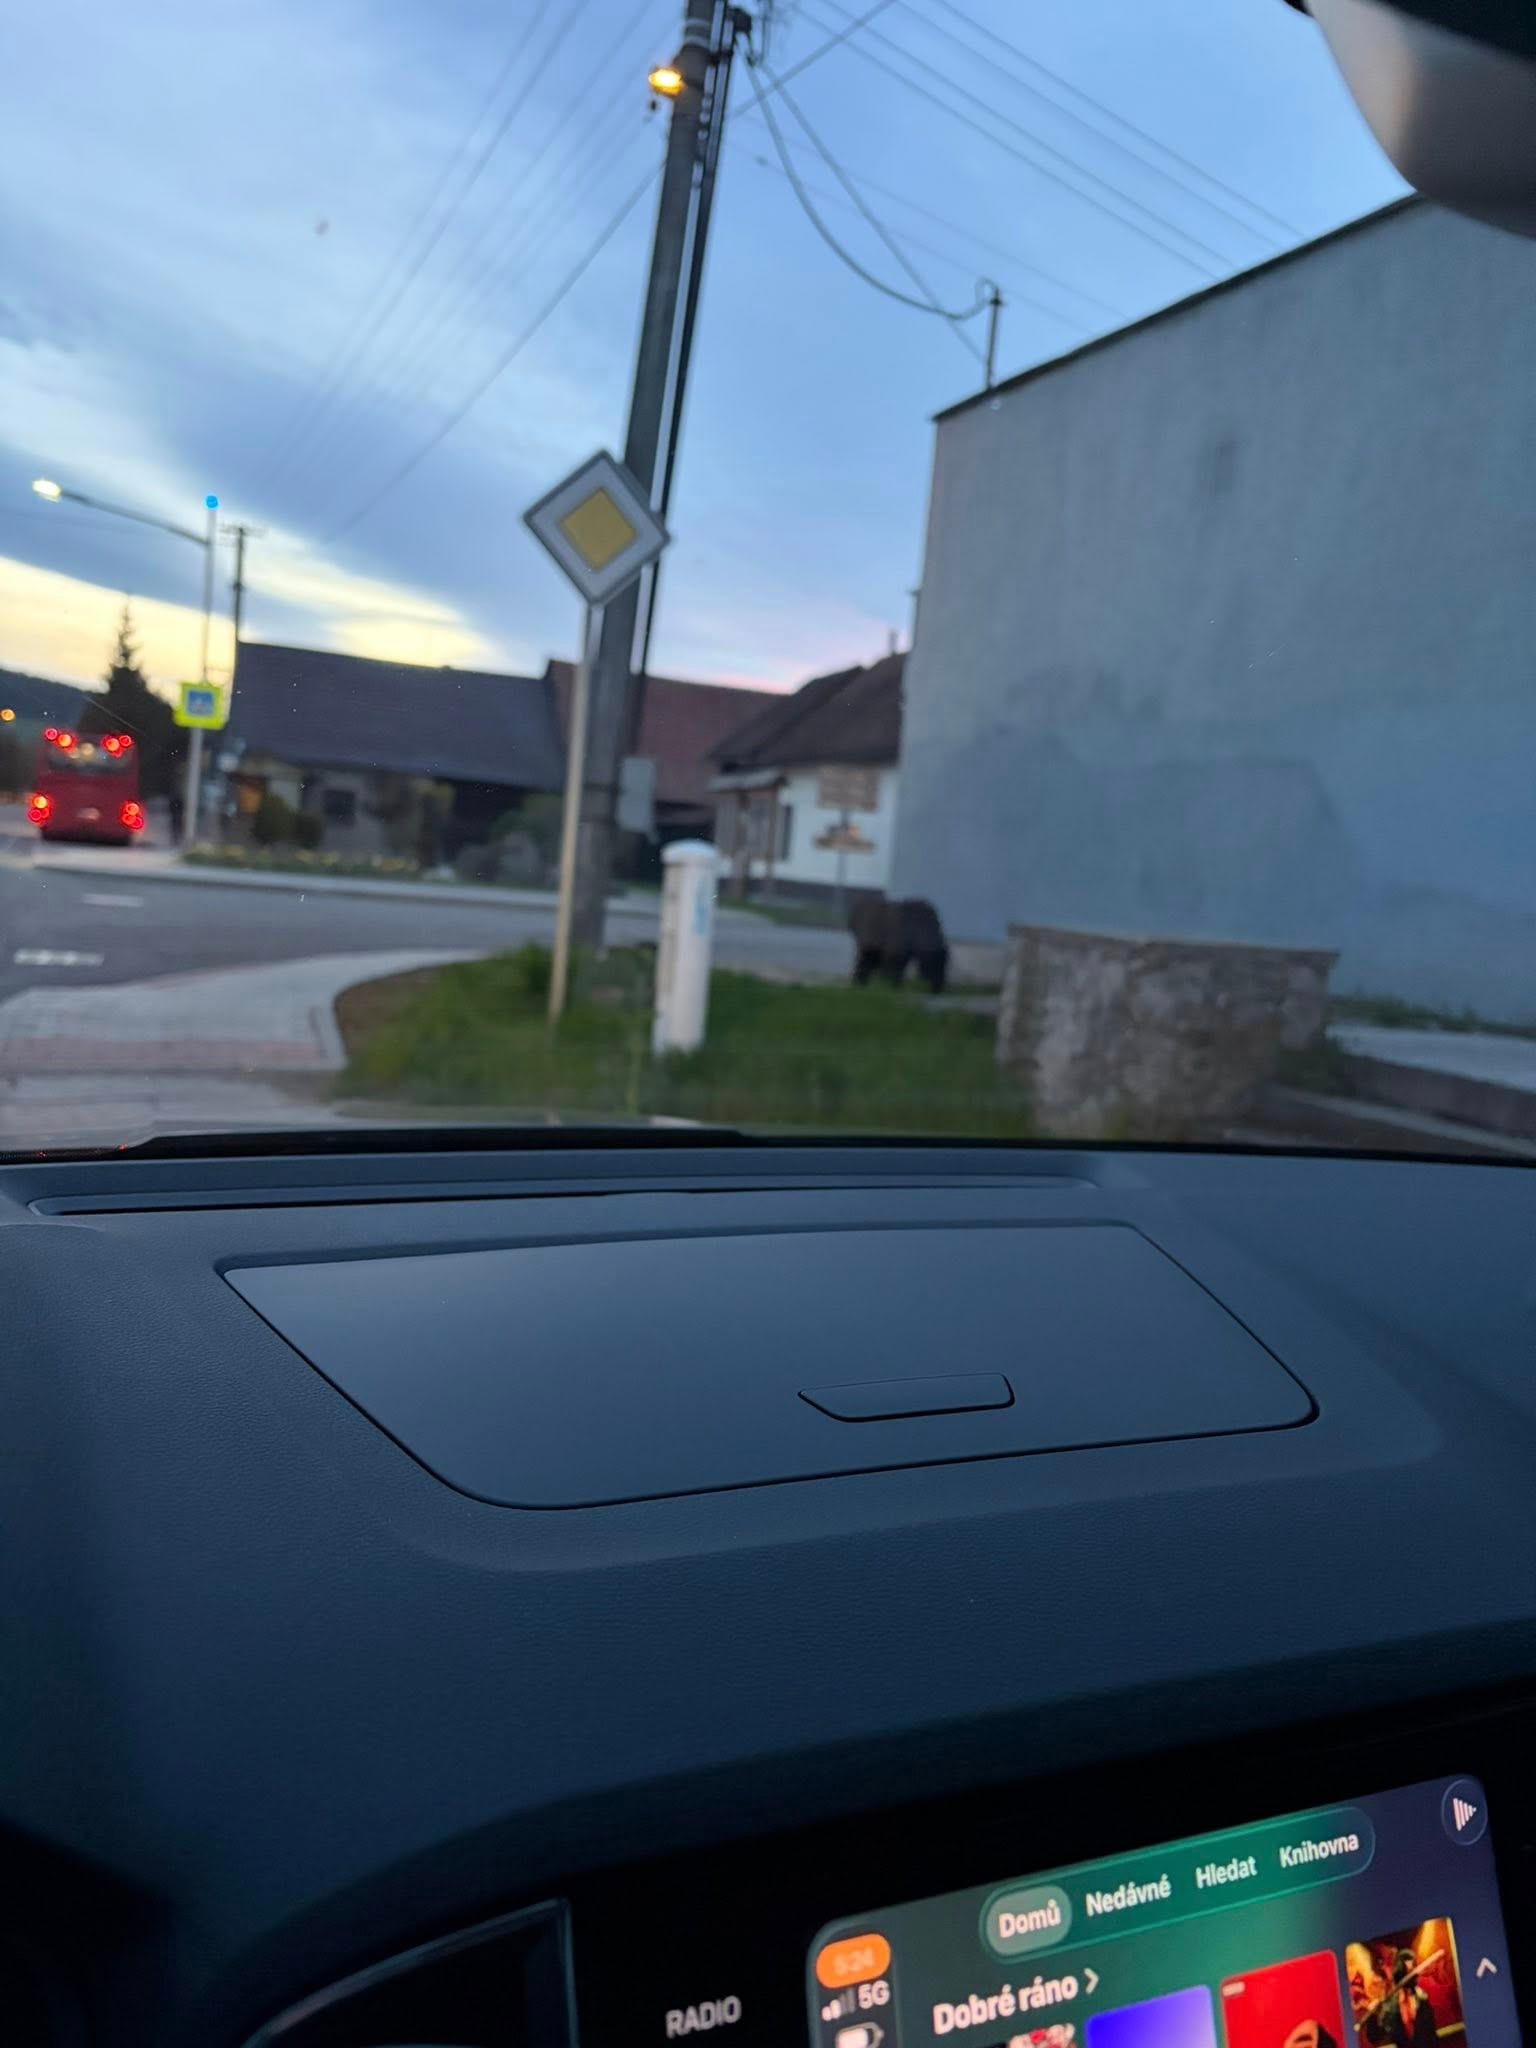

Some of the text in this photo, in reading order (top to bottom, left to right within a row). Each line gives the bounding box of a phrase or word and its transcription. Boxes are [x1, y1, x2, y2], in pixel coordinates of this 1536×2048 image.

[999, 1833, 1360, 1939] Domů Nedávné Hledat Knihovna
[665, 1995, 742, 2039] RADIO
[858, 1979, 890, 2010] 5G
[933, 1975, 1079, 2035] Dobré ráno
